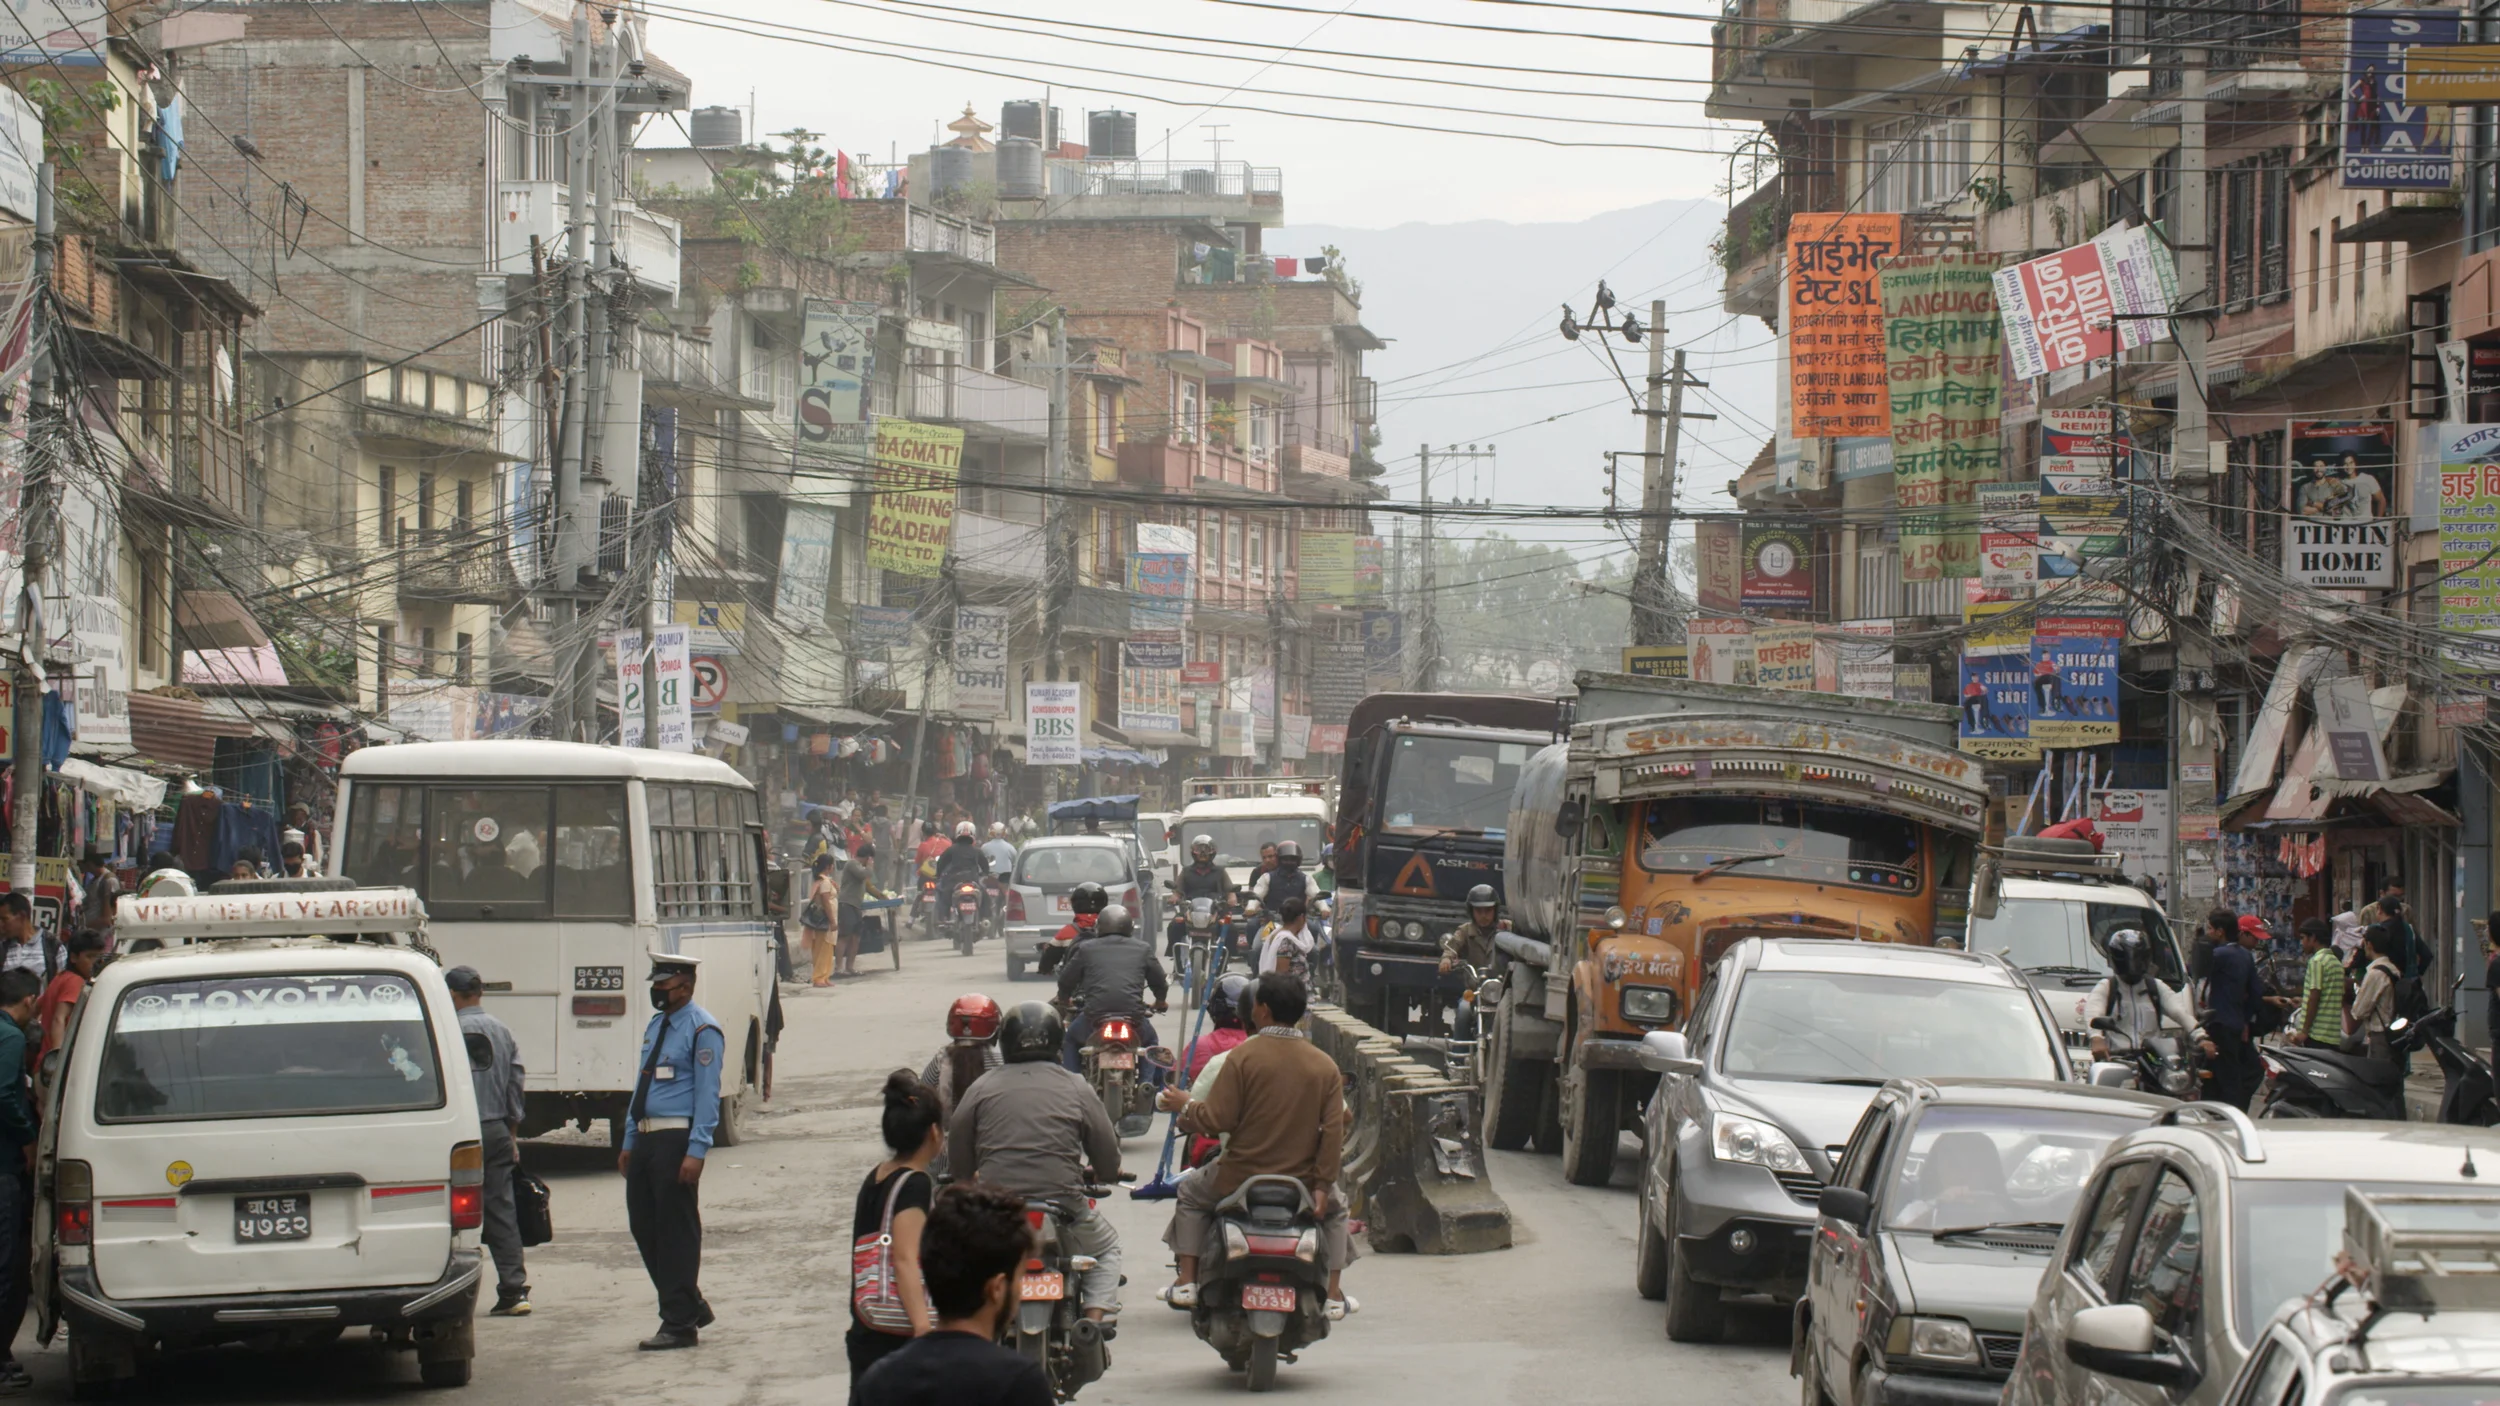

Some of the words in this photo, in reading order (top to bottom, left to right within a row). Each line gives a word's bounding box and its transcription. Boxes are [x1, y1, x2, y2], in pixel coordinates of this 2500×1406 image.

[2346, 158, 2450, 180] Collection
[2003, 268, 2025, 312] School
[2018, 314, 2044, 376] Language
[1795, 373, 1840, 387] COMPUTER
[2060, 422, 2107, 431] REMIT
[876, 432, 960, 467] BAGMATI
[874, 460, 955, 494] HOTEL
[870, 487, 953, 518] TRAINING
[869, 514, 950, 546] ACADEMY
[2294, 525, 2389, 545] TIFFIN
[904, 545, 937, 561] LTD.
[2301, 552, 2382, 571] HOME
[1635, 660, 1688, 669] WESTERN
[1652, 668, 1688, 677] UNION
[693, 666, 718, 698] P
[2070, 672, 2104, 686] SHOE
[1051, 688, 1077, 698] ACADEMY
[1997, 690, 2028, 704] SHOE
[1033, 717, 1075, 736] BBS
[2080, 724, 2113, 735] Style
[1975, 749, 2028, 759] Style
[1436, 858, 1490, 871] ASHOK
[134, 903, 198, 923] VISIT
[211, 900, 292, 921] NEPAL
[296, 900, 359, 919] YEAR
[362, 898, 408, 917] 2011
[576, 977, 622, 989] 4799
[171, 984, 370, 1014] TOYOTA
[240, 1216, 309, 1238] ५७६२
